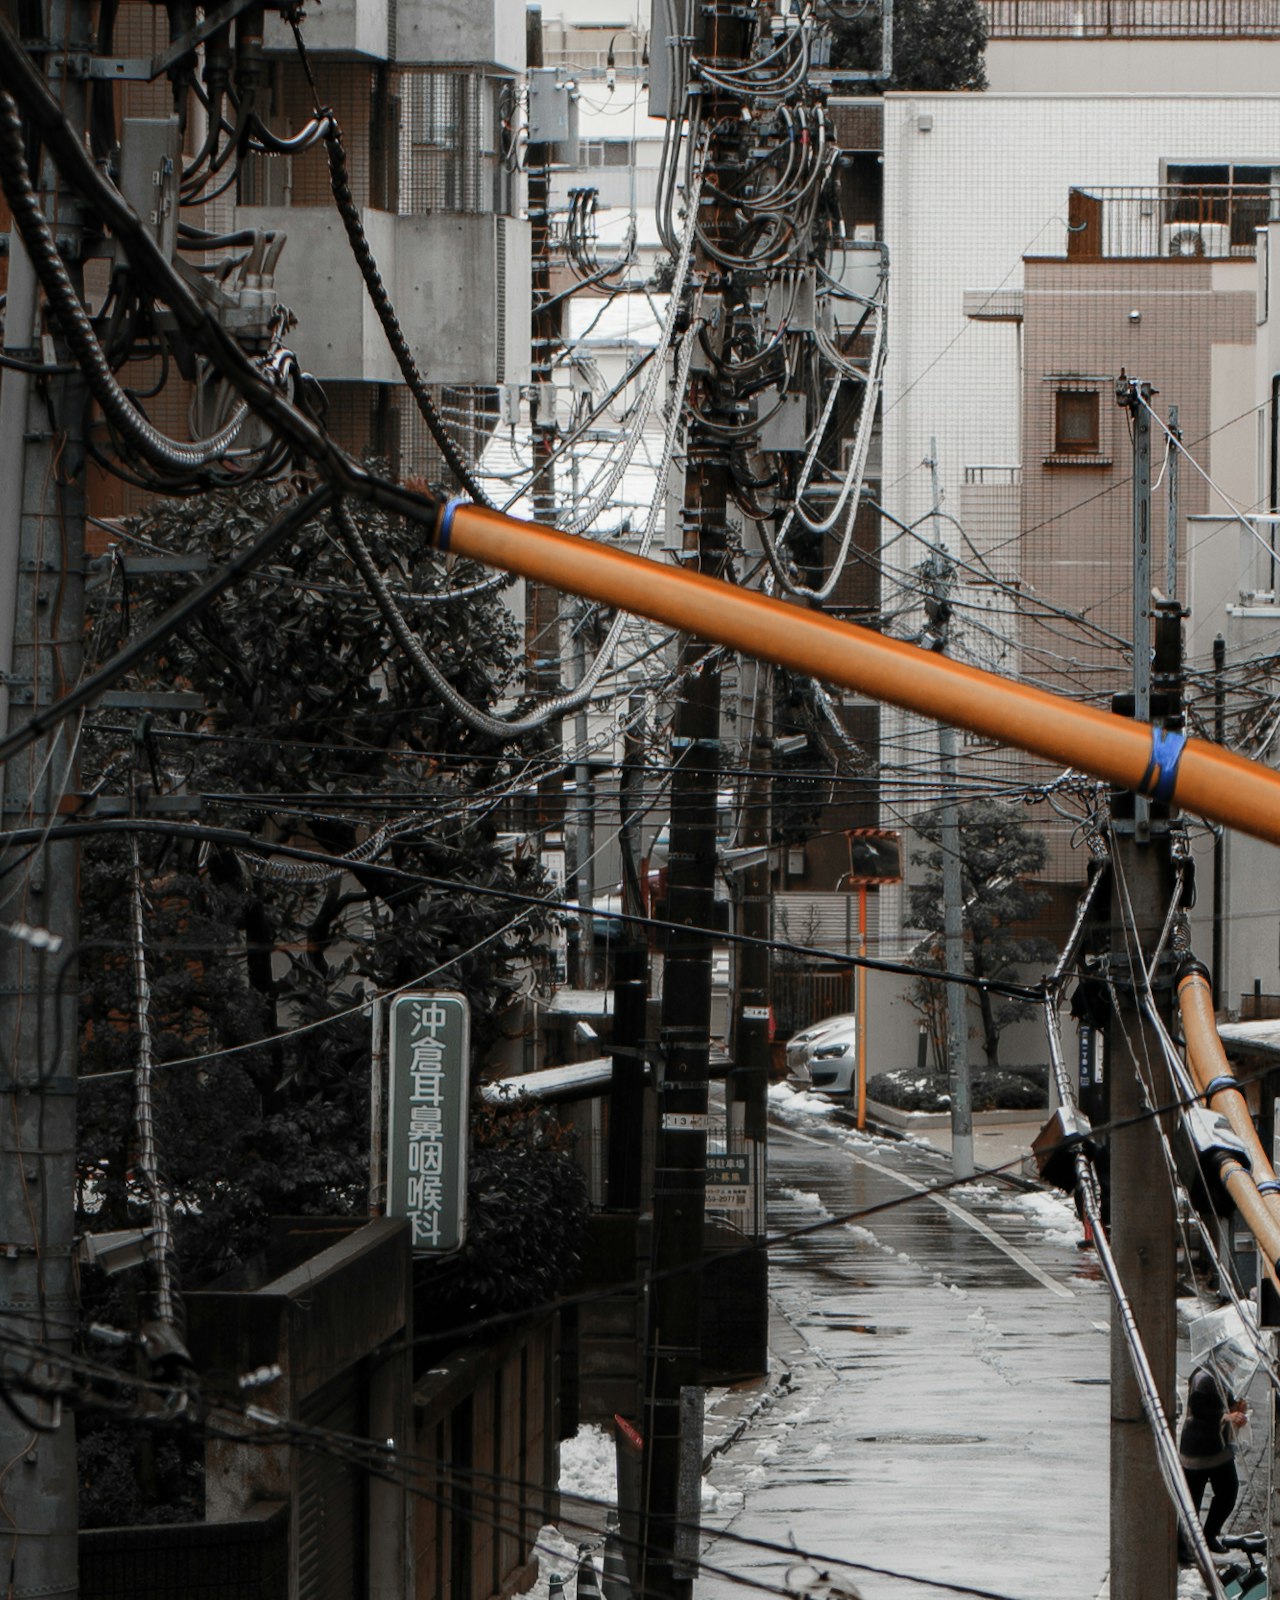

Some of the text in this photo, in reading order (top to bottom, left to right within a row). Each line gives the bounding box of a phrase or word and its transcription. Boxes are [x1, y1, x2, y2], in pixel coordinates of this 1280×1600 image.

[406, 1002, 446, 1246] 沖倉耳鼻咽喉科
